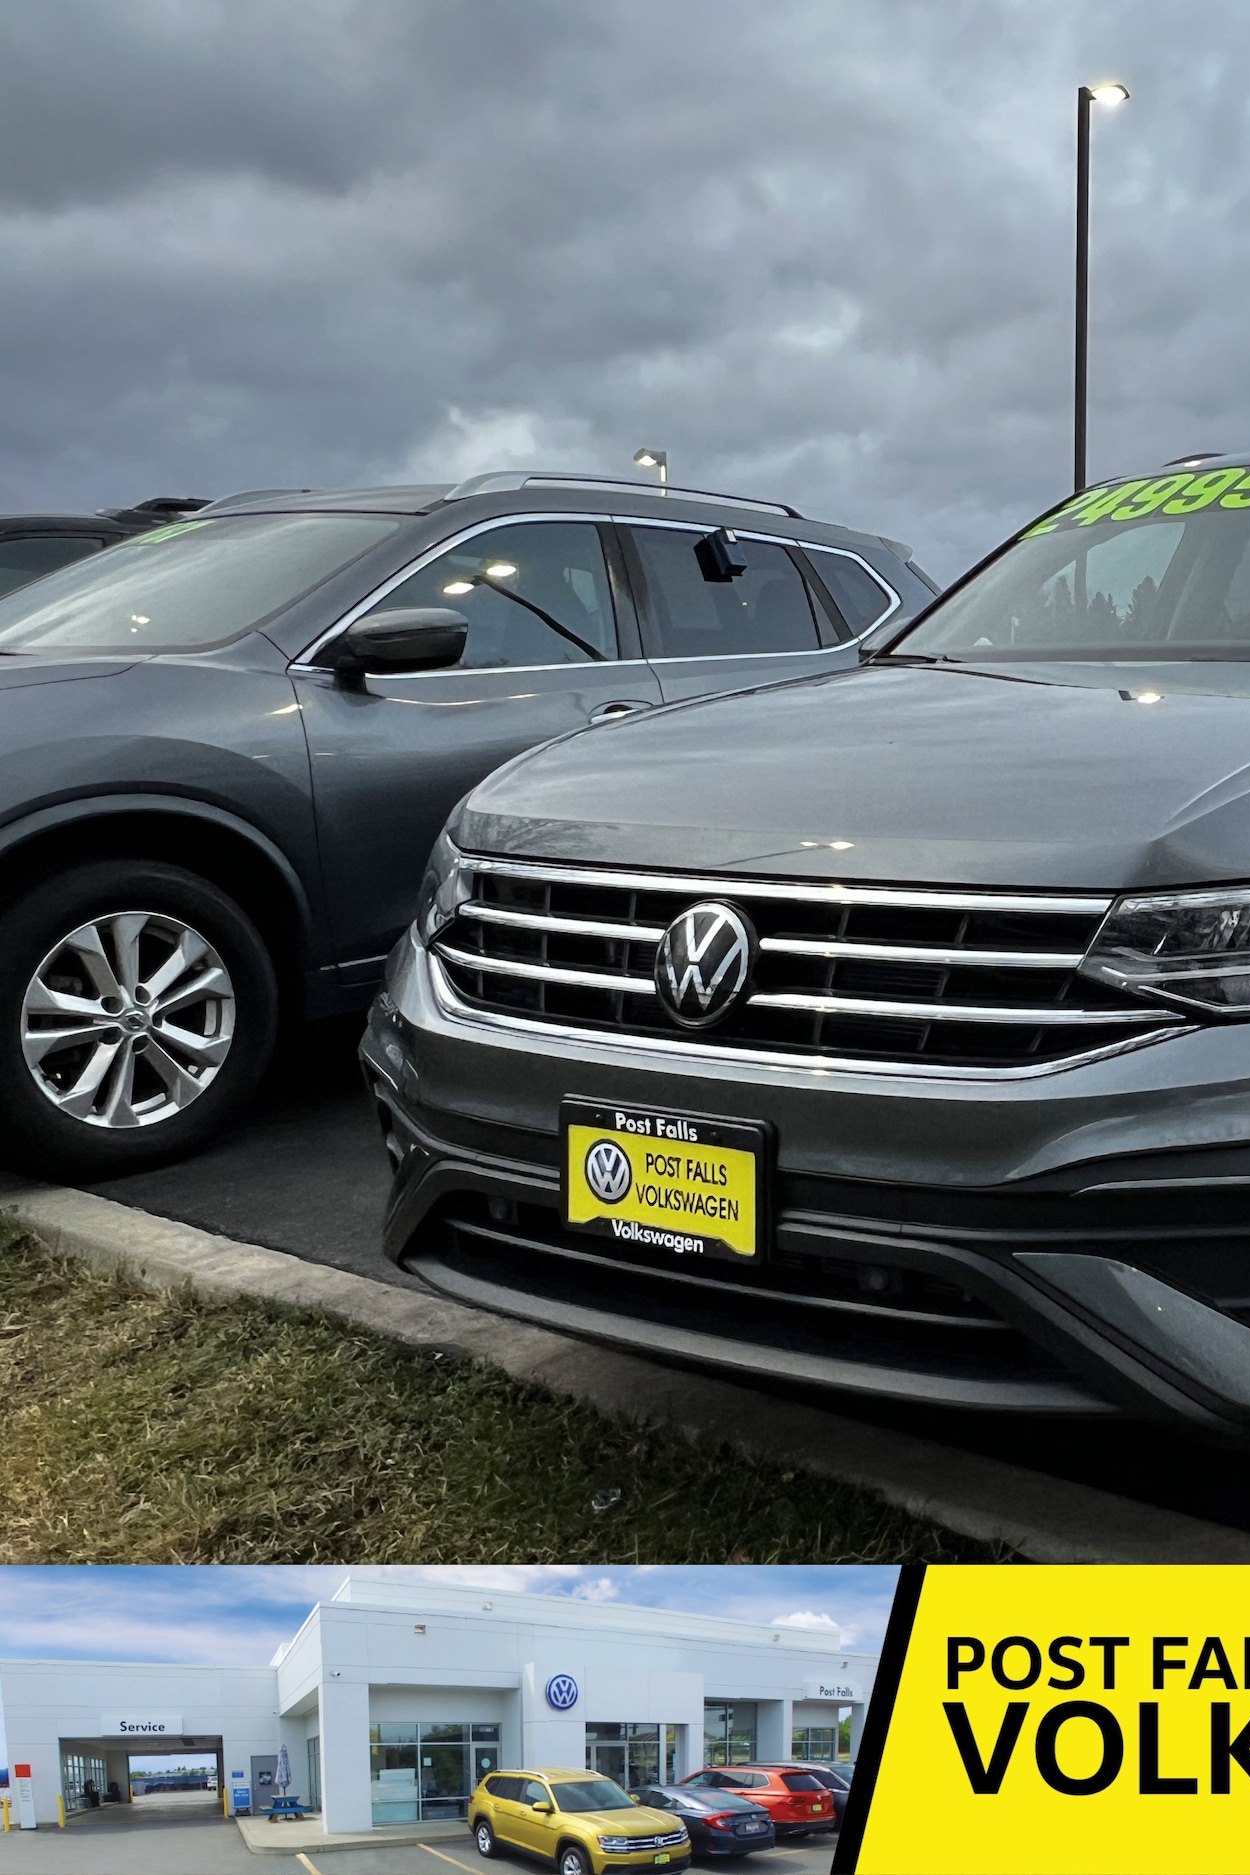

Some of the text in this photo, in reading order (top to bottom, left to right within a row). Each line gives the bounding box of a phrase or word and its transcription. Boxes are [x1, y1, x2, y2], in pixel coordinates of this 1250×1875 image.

[615, 1112, 698, 1141] Post Falls
[645, 1152, 727, 1186] POST FALLS
[635, 1183, 739, 1221] VOLKSWAGEN
[611, 1218, 704, 1253] Volkswagen
[819, 1686, 853, 1697] Post Falls
[119, 1720, 165, 1732] Service
